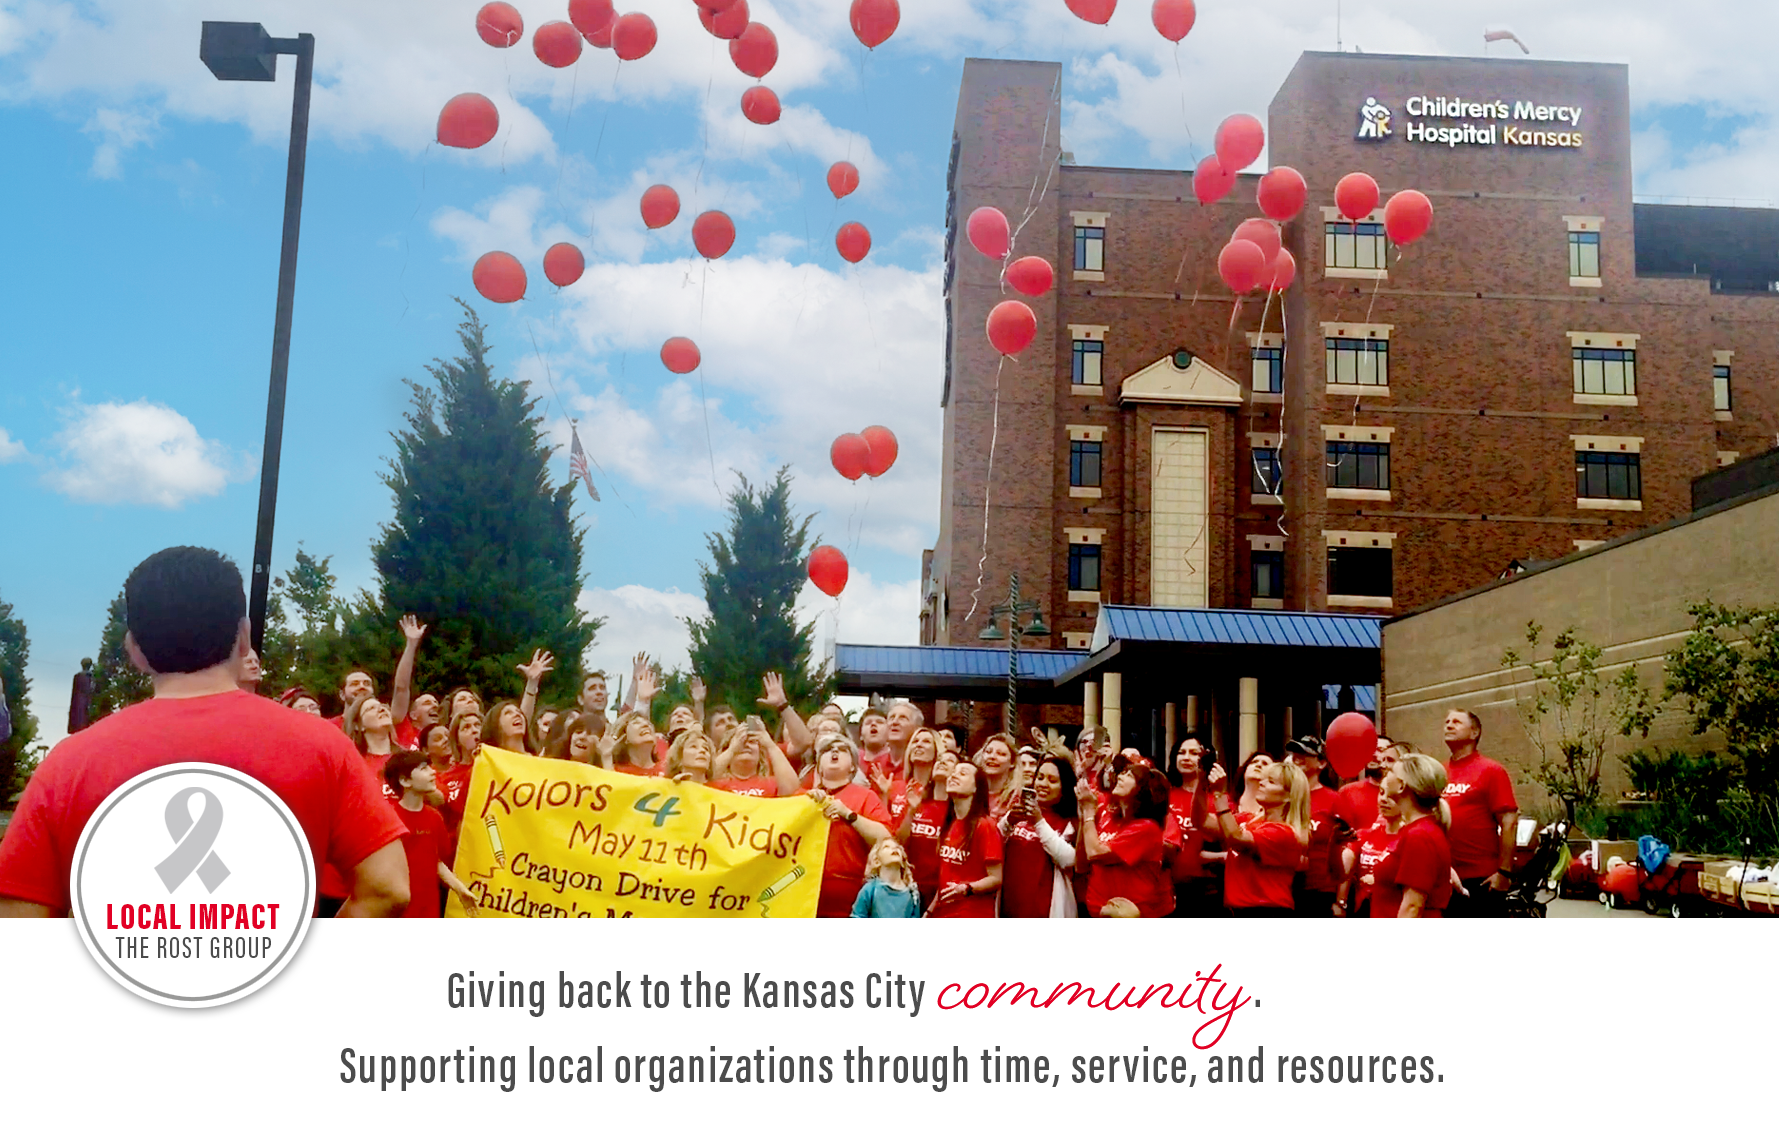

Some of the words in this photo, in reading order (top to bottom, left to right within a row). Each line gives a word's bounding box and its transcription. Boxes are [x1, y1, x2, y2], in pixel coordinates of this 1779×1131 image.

[1405, 97, 1509, 119] Children's
[1513, 101, 1582, 126] Mercy
[1406, 122, 1496, 147] Hospital
[1503, 126, 1583, 147] Kansas
[480, 777, 613, 818] Kolors
[634, 792, 681, 827] 4
[703, 803, 802, 864] Kids!
[568, 820, 635, 859] May
[510, 852, 602, 893] Crayon
[615, 871, 696, 906] Drive
[708, 886, 751, 911] for
